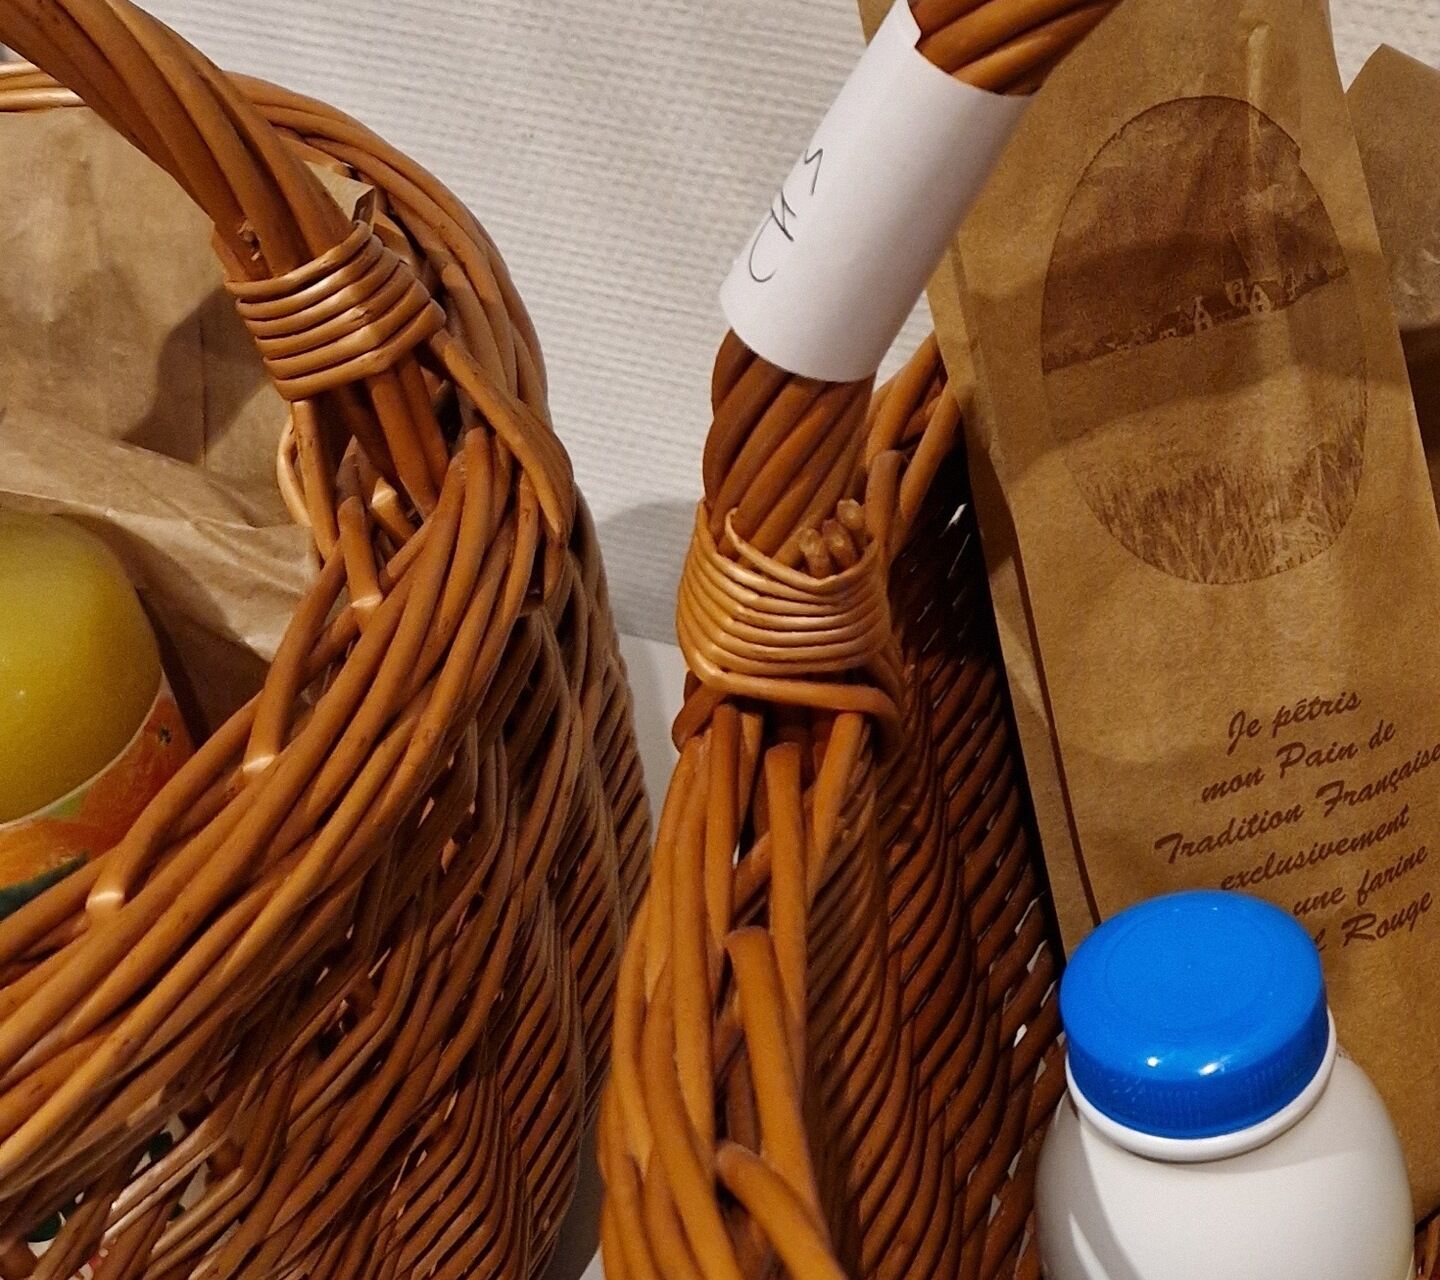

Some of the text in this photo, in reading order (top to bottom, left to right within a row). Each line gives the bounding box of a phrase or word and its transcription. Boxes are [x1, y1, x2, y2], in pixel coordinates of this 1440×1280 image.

[1226, 691, 1361, 756] Je pétris
[1201, 720, 1396, 803] mon Pain de
[1153, 804, 1304, 864] Tradition
[1221, 804, 1410, 891] exclusivement
[1357, 846, 1428, 907] farine
[1341, 892, 1433, 947] Rouge
